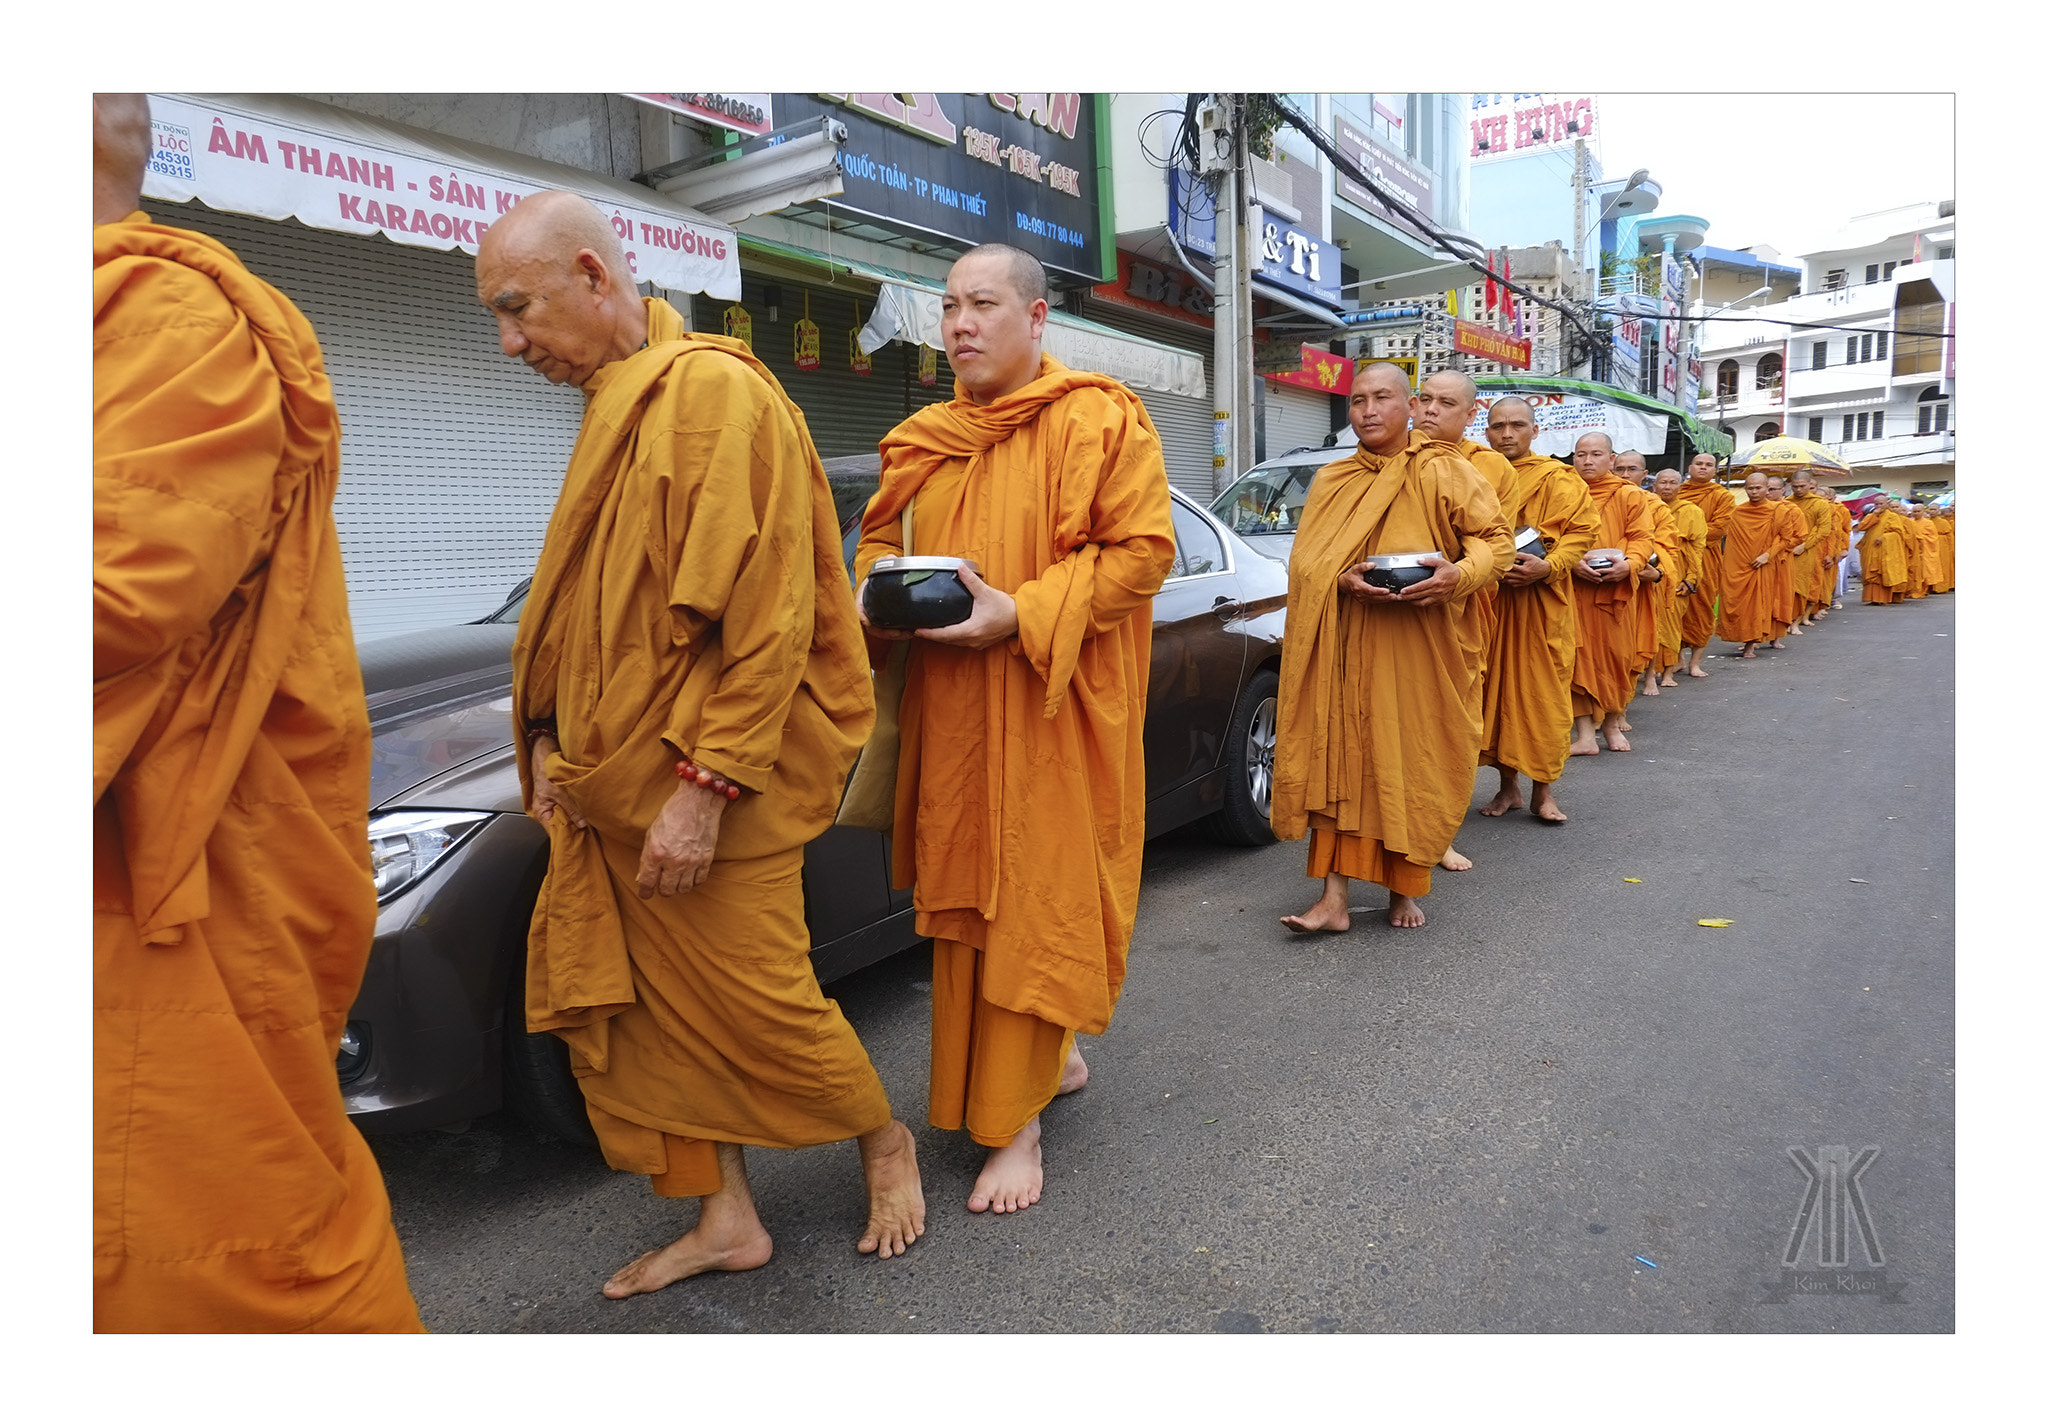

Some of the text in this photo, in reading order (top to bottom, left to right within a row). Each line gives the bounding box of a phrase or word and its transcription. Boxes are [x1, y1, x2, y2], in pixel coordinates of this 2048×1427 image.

[207, 116, 269, 164] ÂM
[278, 140, 394, 192] THANH
[429, 173, 486, 211] SÂN
[640, 223, 727, 261] TRƯỜNG
[845, 153, 876, 182] QUỐC
[878, 163, 907, 192] TOẢN
[914, 176, 928, 198] TP
[931, 182, 959, 209] PHAN
[960, 191, 987, 217] THIẾT
[1286, 230, 1321, 282] Ti
[1461, 331, 1479, 349] KHU
